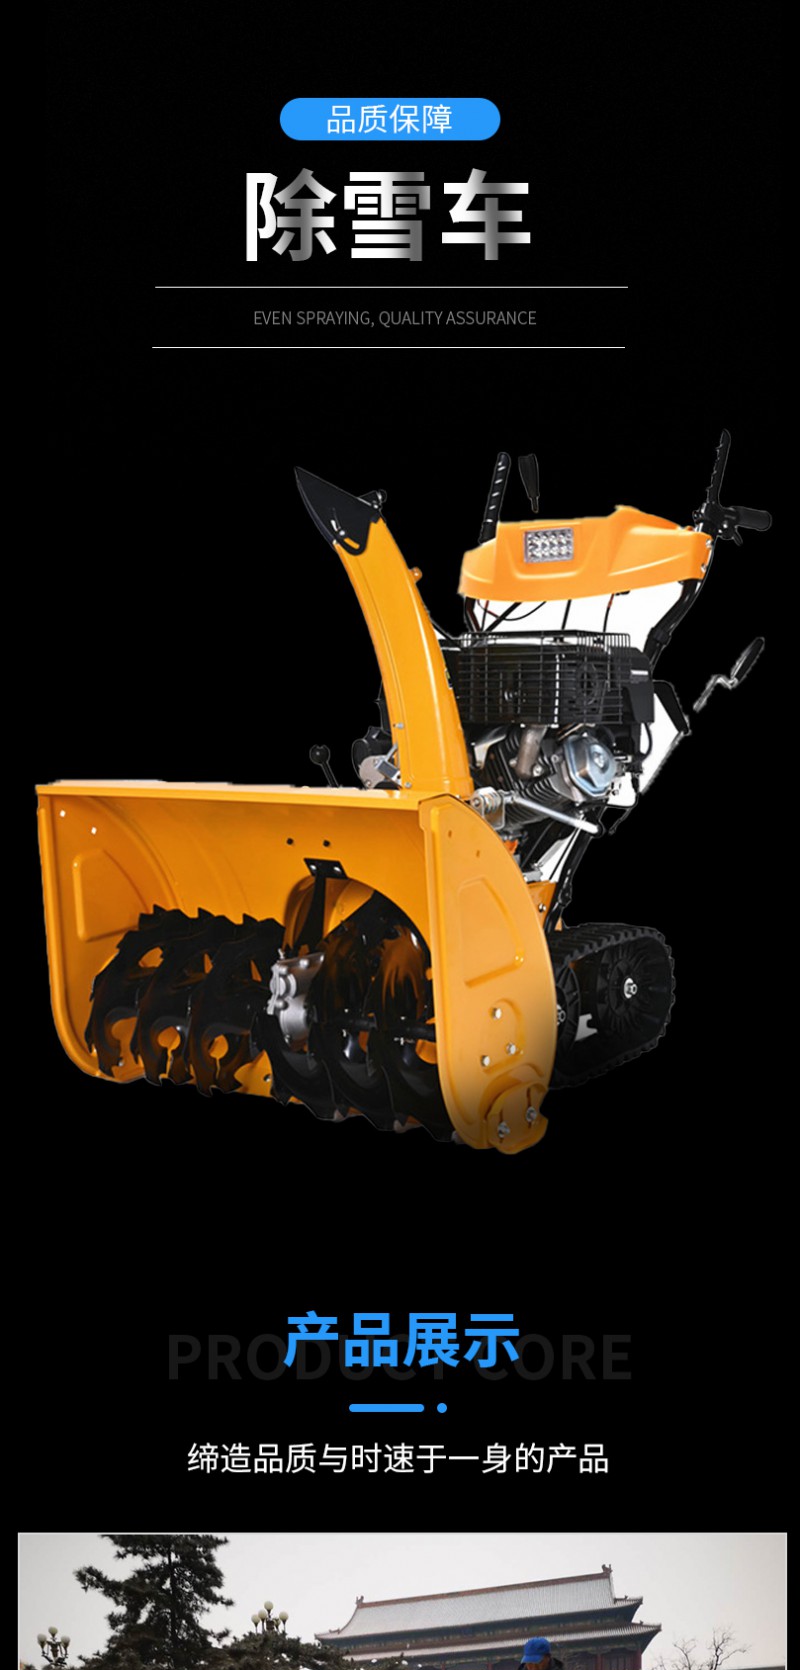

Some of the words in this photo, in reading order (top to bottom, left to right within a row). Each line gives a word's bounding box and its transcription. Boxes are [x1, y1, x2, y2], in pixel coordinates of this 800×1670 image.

[328, 104, 452, 133] 品质保障
[246, 168, 531, 261] 除雪车
[255, 311, 291, 325] EVEN
[297, 311, 374, 327] SPRAYING,
[379, 311, 442, 327] QUALITY
[446, 311, 536, 325] ASSURANCE
[283, 1310, 520, 1368] 产品展示
[188, 1442, 608, 1473] 缔造品质与时速于一身的产品
